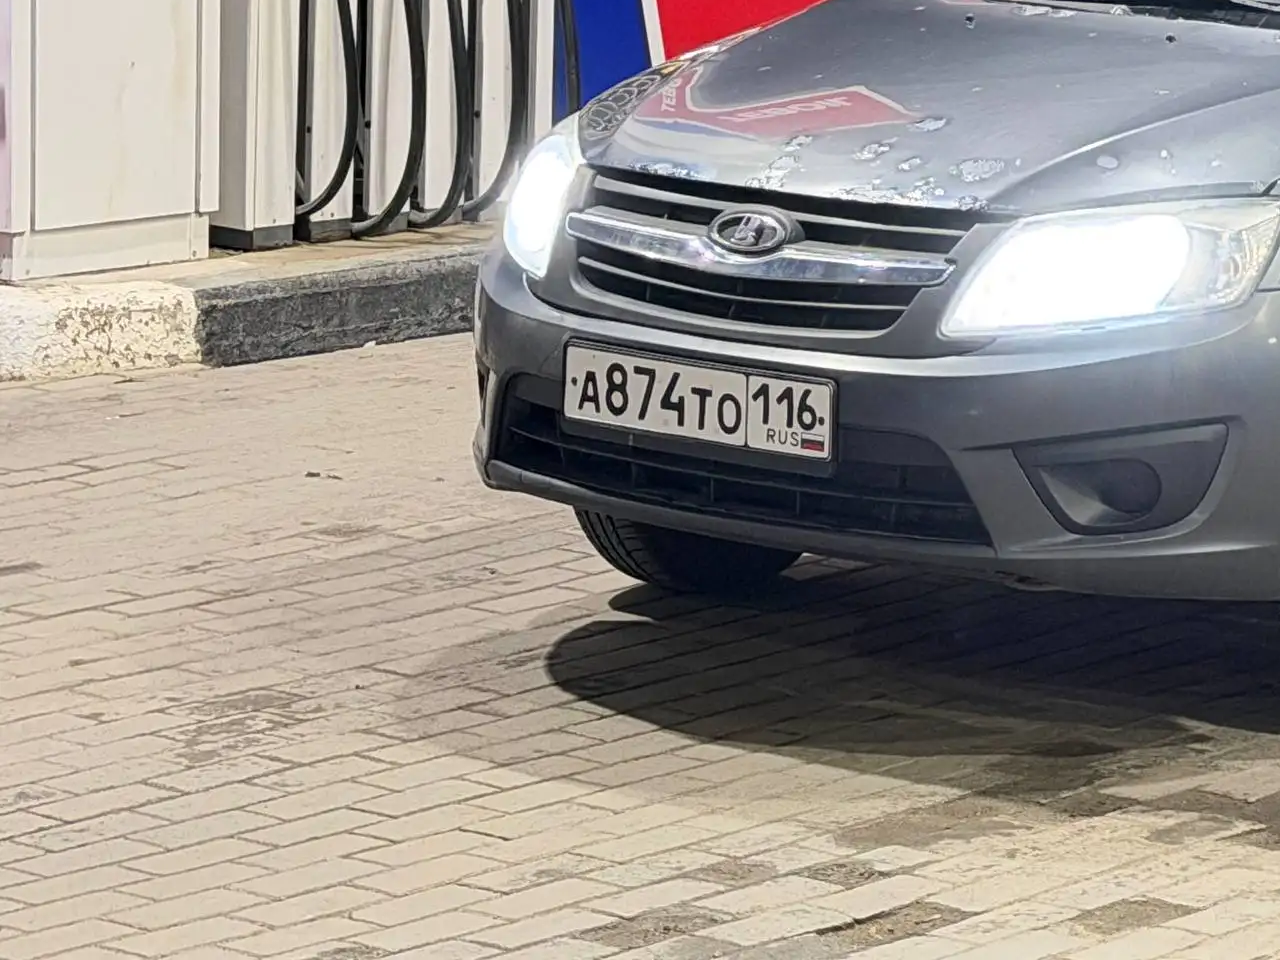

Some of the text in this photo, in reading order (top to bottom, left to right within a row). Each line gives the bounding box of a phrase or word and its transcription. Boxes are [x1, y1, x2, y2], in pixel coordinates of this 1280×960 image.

[577, 362, 818, 435] А874ТО 116
[766, 427, 800, 447] RUS
